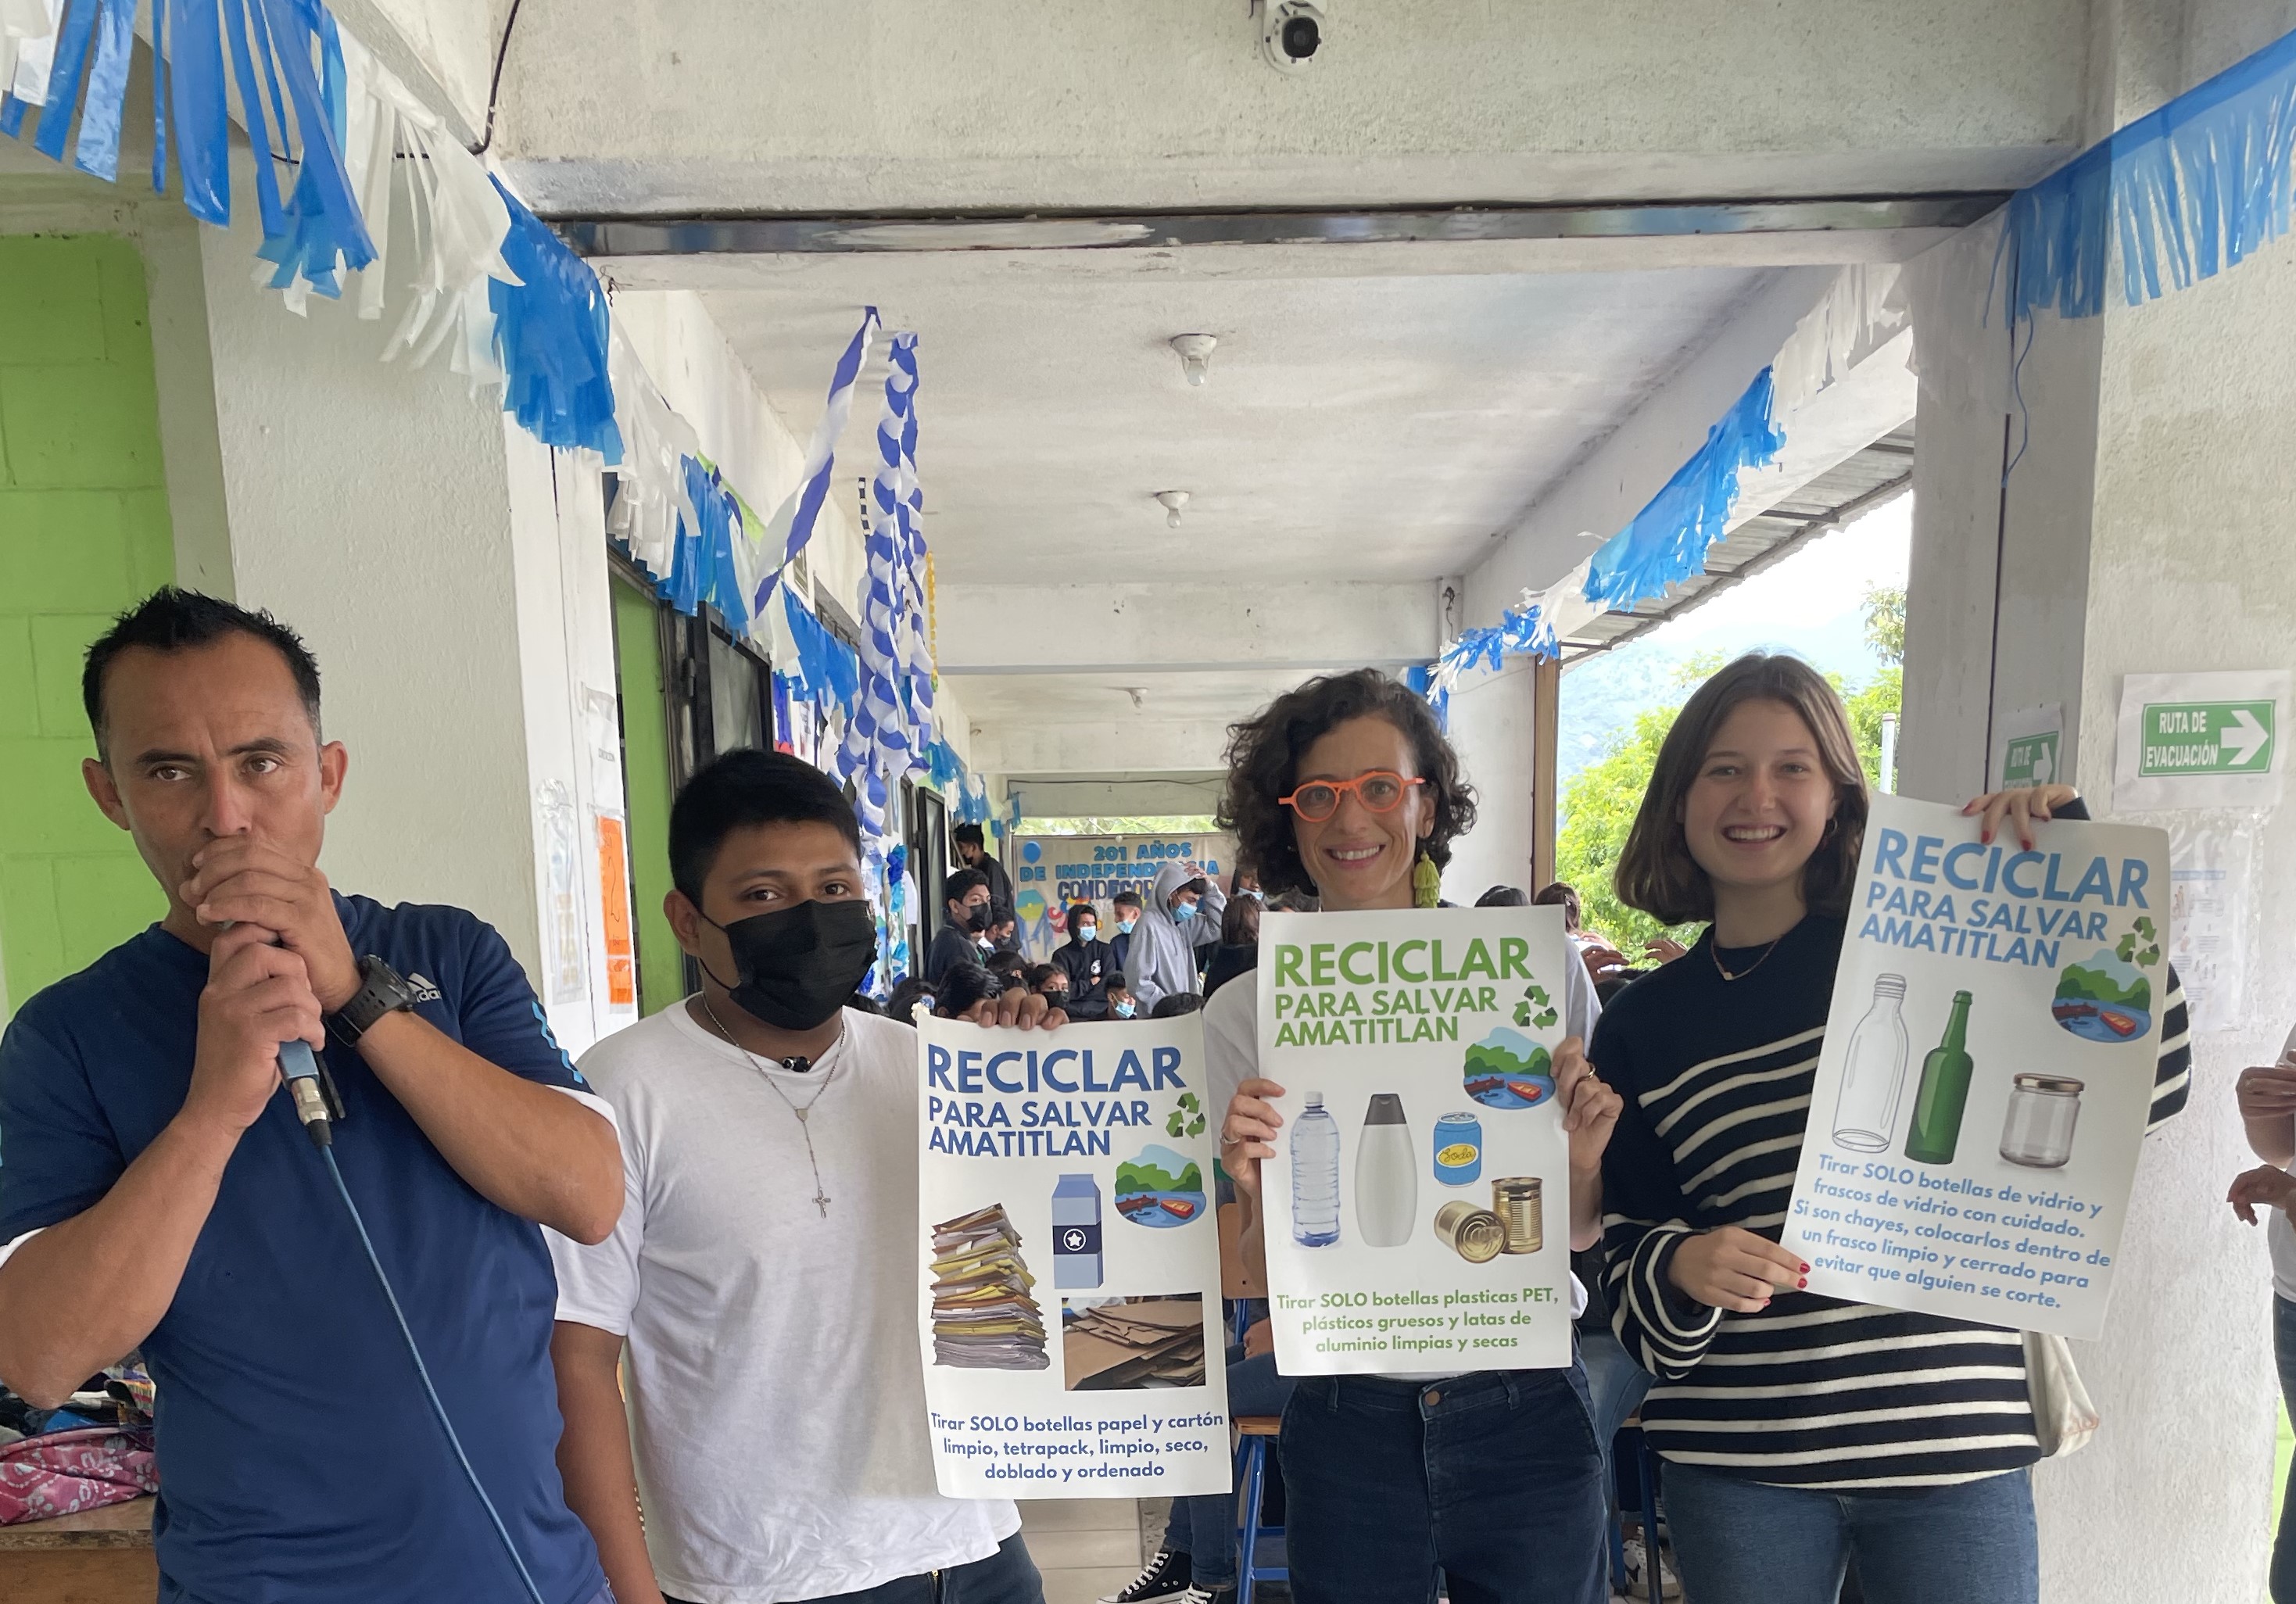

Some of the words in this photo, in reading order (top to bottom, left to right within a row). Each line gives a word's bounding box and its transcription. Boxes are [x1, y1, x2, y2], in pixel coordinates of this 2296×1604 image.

[2158, 713, 2187, 734] RUTA
[2192, 711, 2206, 732] DE
[2145, 740, 2218, 768] EVACUACIÓN
[1094, 846, 1127, 861] 201
[1137, 840, 1191, 859] AÑOS
[1020, 866, 1046, 882] DE
[1873, 828, 2150, 908] RECICLAR
[1866, 881, 1955, 923] PARA
[1966, 900, 2108, 941] SALVAR
[1275, 937, 1535, 987] RECICLAR
[1275, 991, 1363, 1019] PARA
[1371, 987, 1499, 1015] SALVAR
[928, 1044, 1187, 1093] RECICLAR
[929, 1096, 1012, 1127] PARA
[1020, 1101, 1152, 1127] SALVAR
[1819, 1154, 1859, 1176] Tirar
[1864, 1163, 1913, 1184] SOLO
[1918, 1173, 1993, 1199] botellas
[1997, 1186, 2022, 1202] de
[2028, 1192, 2084, 1213] vidrio
[2089, 1203, 2102, 1219] y
[1814, 1178, 1872, 1202] frascos
[1876, 1190, 1897, 1207] de
[1904, 1195, 1958, 1216] vidrio
[1962, 1208, 1995, 1223] con
[2000, 1213, 2085, 1238] cuidado.
[1793, 1200, 1808, 1215] Si
[1812, 1205, 1840, 1221] son
[1844, 1209, 1908, 1236] chayes,
[1914, 1223, 2010, 1251] colocarlos
[2015, 1237, 2080, 1262] dentro
[2086, 1249, 2110, 1267] de
[1802, 1230, 1821, 1244] un
[1826, 1230, 1877, 1252] frasco
[1881, 1240, 1939, 1264] limpio
[1943, 1254, 1955, 1269] y
[1960, 1256, 2036, 1280] cerrado
[2040, 1270, 2089, 1289] para
[1814, 1255, 1864, 1273] evitar
[1868, 1265, 1901, 1281] que
[1905, 1270, 1975, 1294] alguien
[1980, 1283, 2001, 1297] se
[2005, 1287, 2061, 1309] corte.
[1277, 1294, 1315, 1309] Tirar
[1320, 1292, 1368, 1308] SOLO
[1373, 1290, 1438, 1306] botellas
[1444, 1289, 1517, 1308] plasticas
[1522, 1288, 1558, 1305] PET,
[1302, 1316, 1373, 1334] plásticos
[1378, 1316, 1444, 1333] gruesos
[1449, 1316, 1459, 1330] y
[1463, 1312, 1505, 1327] latas
[1510, 1310, 1531, 1325] de
[1316, 1337, 1388, 1353] aluminio
[1392, 1335, 1452, 1353] limpias
[1457, 1338, 1468, 1352] y
[1472, 1336, 1518, 1348] secas
[931, 1412, 965, 1431] Tirar
[969, 1416, 1019, 1432] SOLO
[1023, 1416, 1093, 1432] botellas
[1098, 1414, 1148, 1434] papel
[1152, 1417, 1163, 1433] y
[1167, 1412, 1223, 1429] cartón
[944, 1438, 999, 1459] limpio,
[1003, 1440, 1094, 1459] tetrapack,
[1099, 1438, 1160, 1459] limpio,
[1165, 1438, 1208, 1453] seco,
[984, 1464, 1057, 1480] doblado
[1062, 1468, 1073, 1482] y
[1077, 1461, 1165, 1478] ordenado
